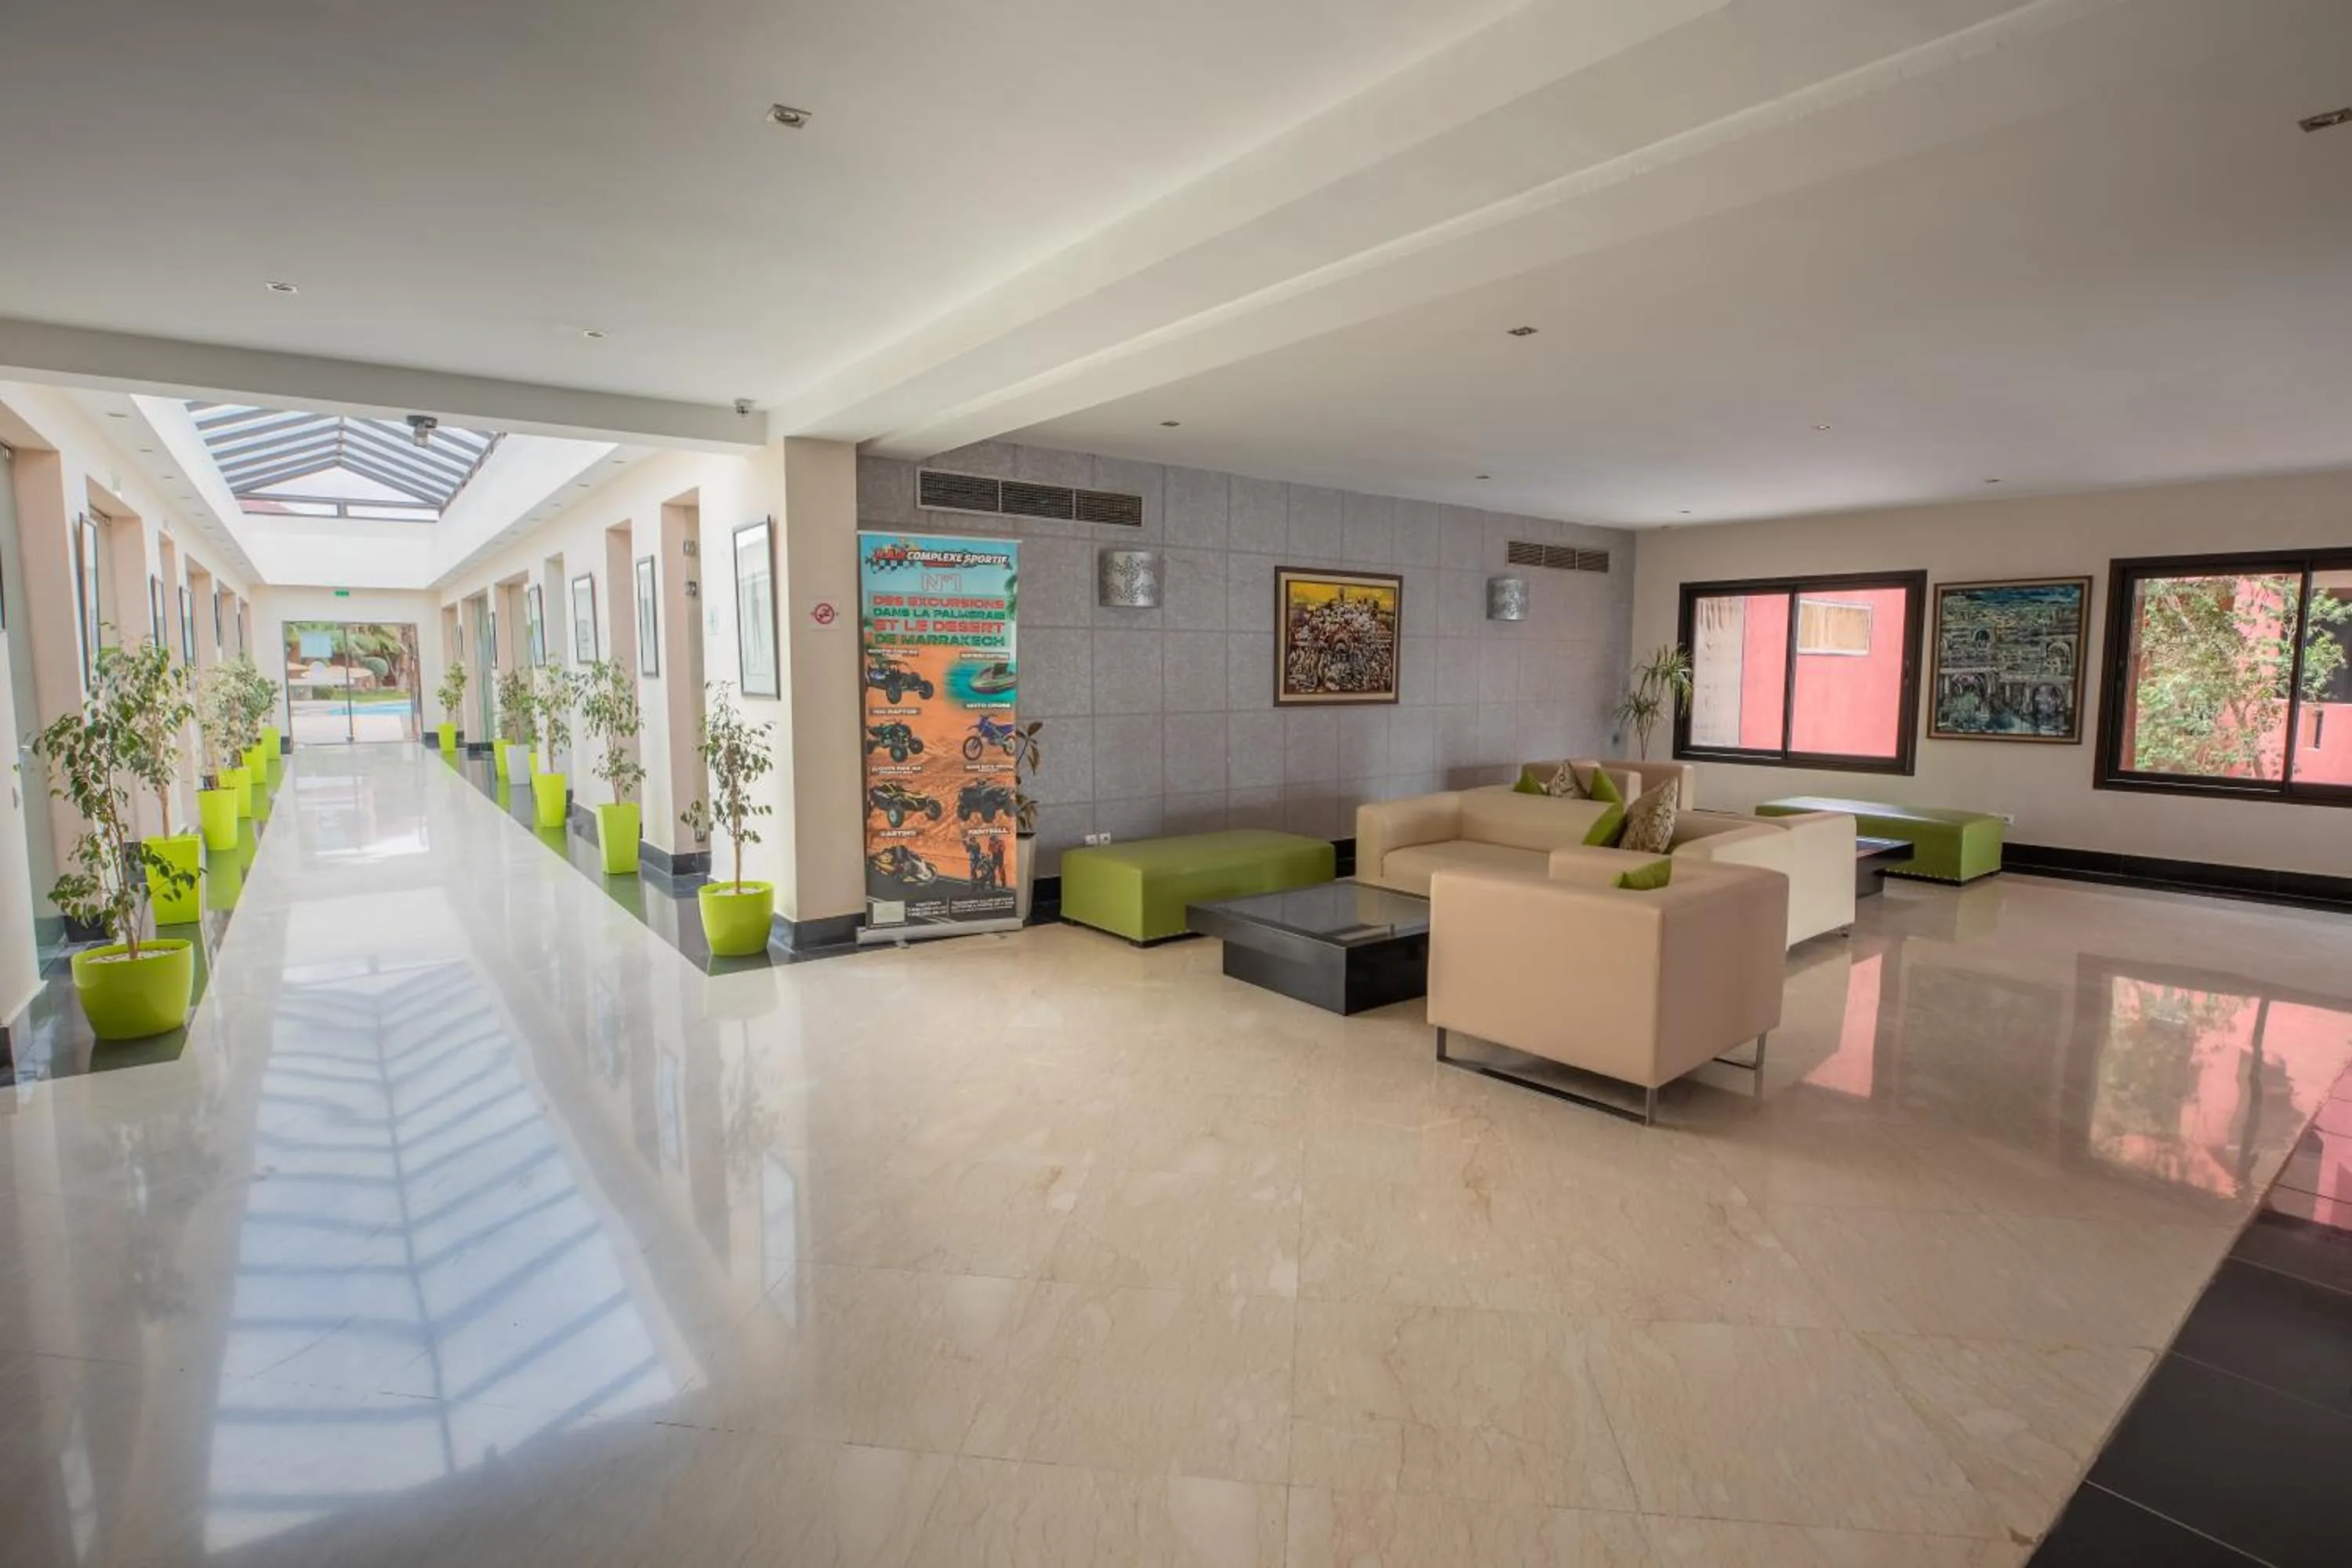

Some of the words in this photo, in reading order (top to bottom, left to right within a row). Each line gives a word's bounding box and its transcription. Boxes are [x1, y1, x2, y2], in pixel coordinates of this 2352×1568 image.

[907, 551, 962, 562] COMPLEXE
[873, 596, 904, 606] DES
[907, 596, 1005, 609] EXCURSIONS
[873, 608, 910, 617] DANS
[913, 609, 931, 618] LA
[873, 619, 899, 631] ET
[904, 620, 928, 632] LE
[933, 620, 1005, 634] DESERT
[874, 633, 896, 644] DE
[902, 633, 1004, 647] MARRAKECH
